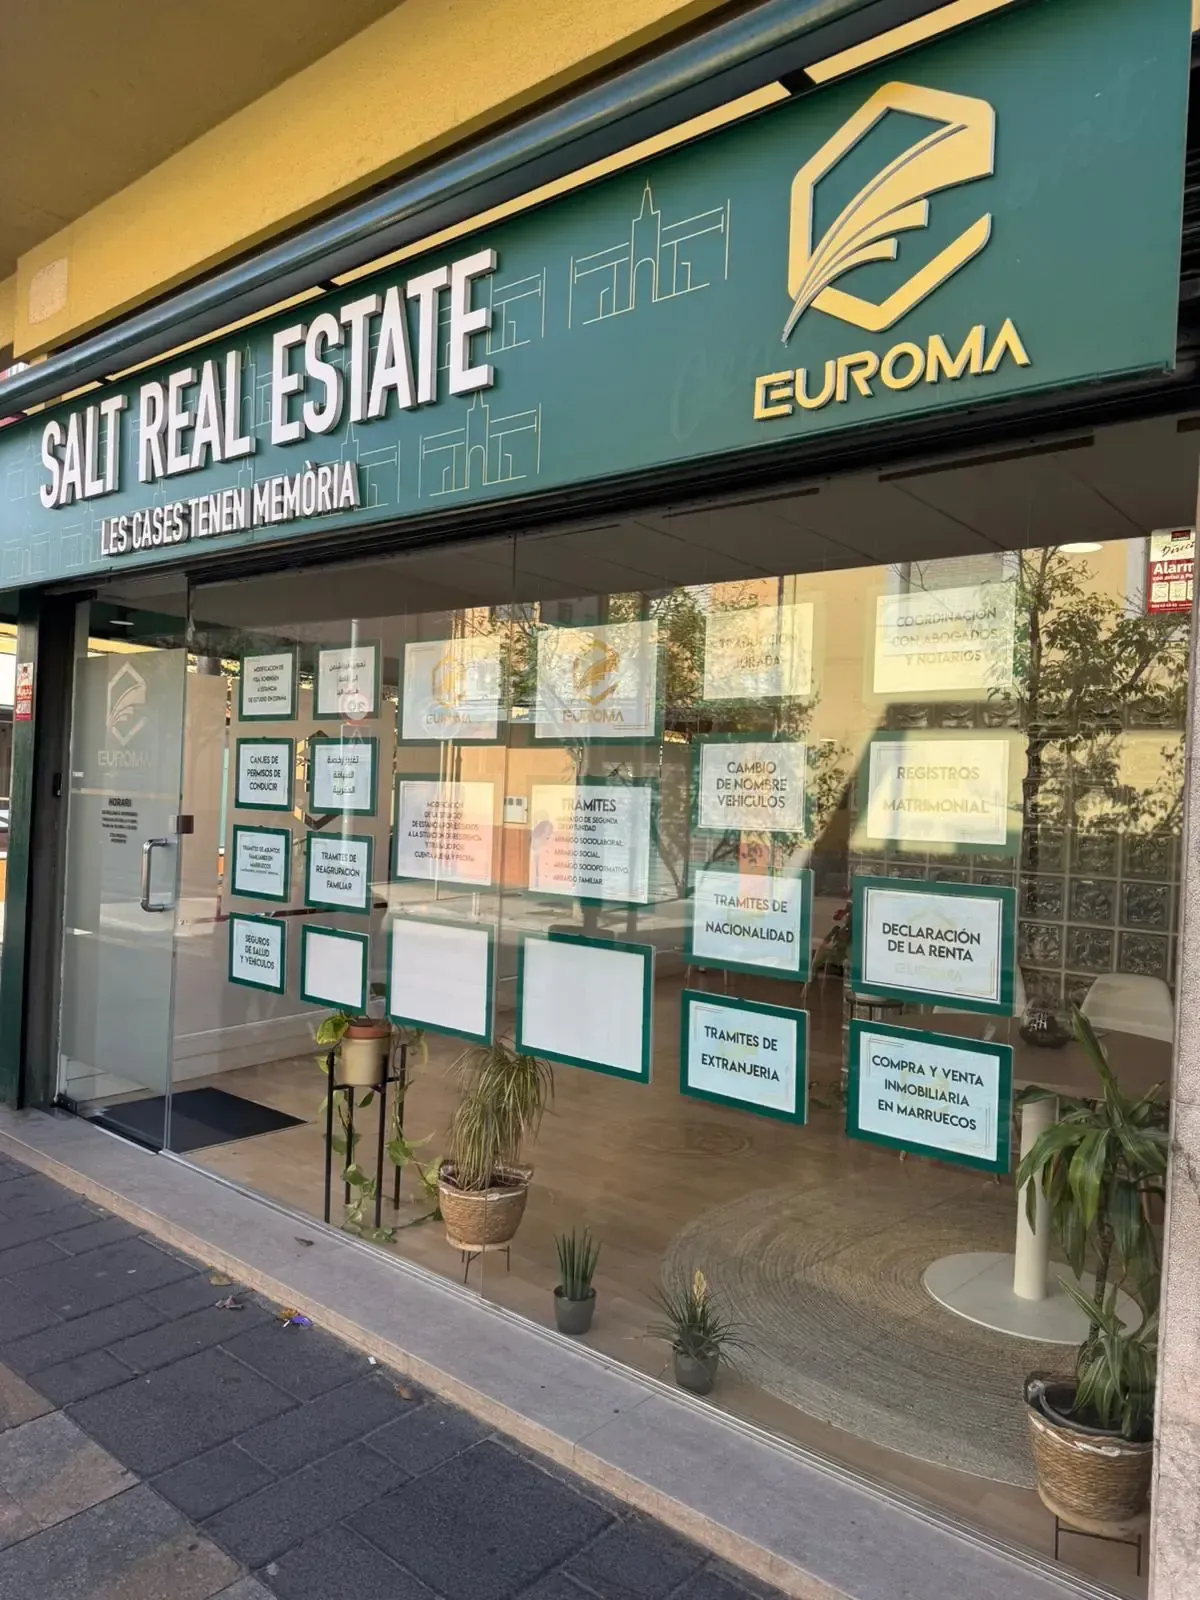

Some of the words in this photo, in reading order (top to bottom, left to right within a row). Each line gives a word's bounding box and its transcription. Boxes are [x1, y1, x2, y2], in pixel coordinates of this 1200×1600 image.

[753, 317, 1031, 420] EUROMA
[40, 394, 128, 509] SALT
[138, 350, 256, 484] REAL
[272, 248, 497, 446] ESTATE
[101, 519, 131, 557] LES
[132, 502, 184, 551] CASES
[187, 487, 250, 539] TENEN
[253, 461, 361, 526] MEMÒRIA
[923, 629, 998, 646] ABOGADOS
[917, 650, 982, 664] NOTARIOS
[250, 756, 270, 764] CANJES
[271, 756, 279, 764] DE
[727, 761, 776, 774] CAMBIO
[247, 769, 272, 778] PERMISOS
[273, 770, 281, 778] DE
[897, 766, 980, 780] REGISTROS
[250, 782, 278, 792] CONDUCIR
[716, 778, 731, 790] DE
[734, 778, 788, 792] NOMBRE
[883, 798, 990, 814] MATRIMONIAL
[322, 852, 348, 862] TRAMITES
[349, 854, 356, 863] DE
[326, 880, 352, 890] FAMILIAR
[714, 893, 769, 911] TRAMITES
[772, 900, 788, 913] DE
[245, 934, 270, 947] SEGUROS
[706, 921, 794, 944] NACIONALIDAD
[882, 922, 981, 946] DECLARACIÓN
[244, 945, 252, 954] DE
[252, 946, 270, 958] SALUD
[888, 939, 904, 953] DE
[908, 942, 926, 956] LA
[929, 944, 974, 962] RENTA
[704, 1025, 759, 1048] TRAMITES
[763, 1036, 778, 1052] DE
[701, 1052, 780, 1082] EXTRANJERIA
[872, 1055, 925, 1076] COMPRA
[930, 1066, 938, 1078] Y
[942, 1067, 985, 1087] VENTA
[884, 1078, 970, 1106] INMOBILIARIA
[878, 1099, 894, 1114] EN
[896, 1102, 977, 1130] MARRUECOS
